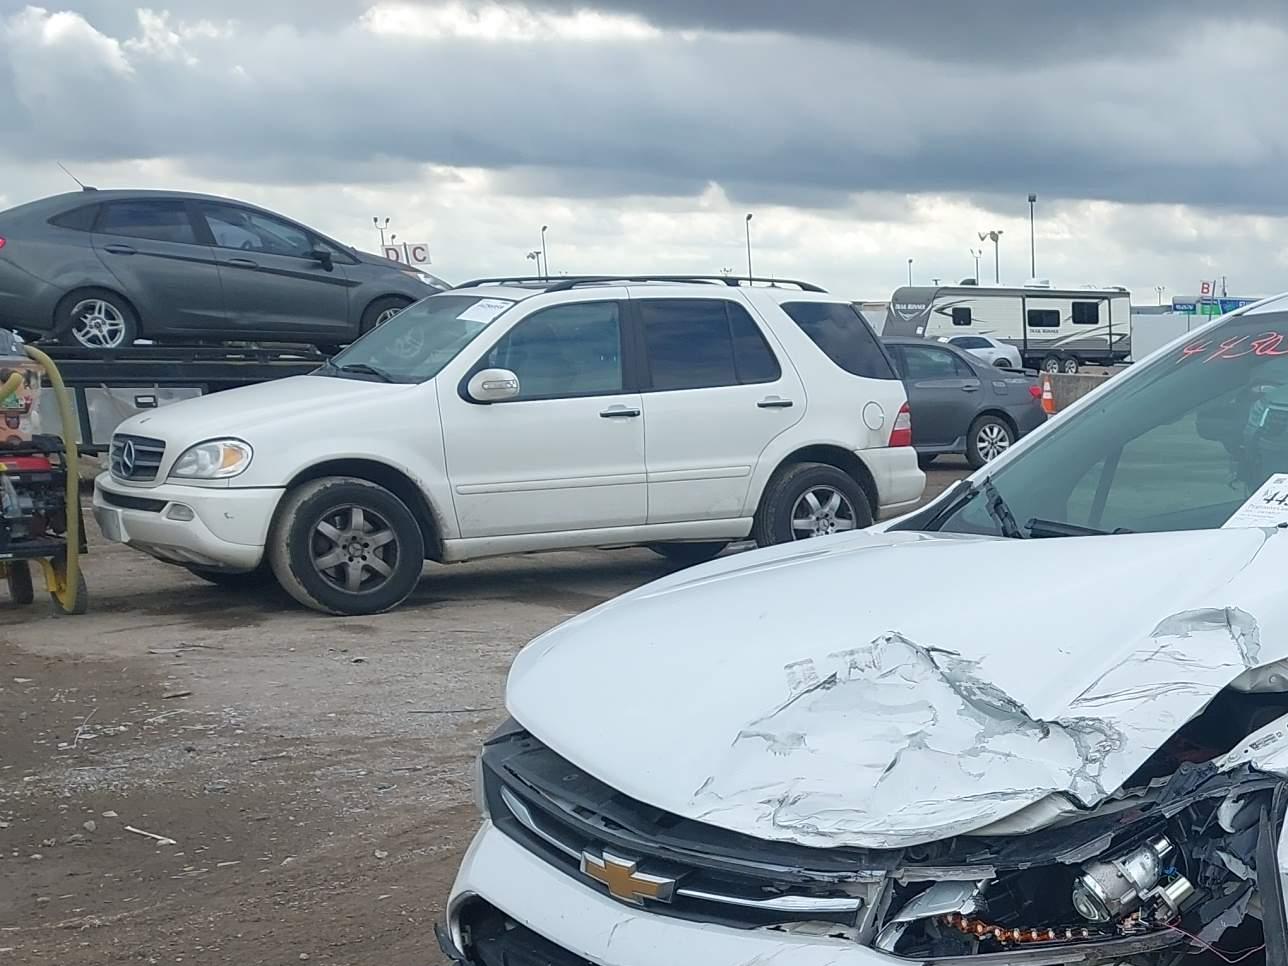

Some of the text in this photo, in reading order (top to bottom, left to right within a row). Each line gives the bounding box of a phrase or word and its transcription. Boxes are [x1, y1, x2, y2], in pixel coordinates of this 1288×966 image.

[385, 247, 400, 262] D
[412, 246, 427, 262] C
[1200, 282, 1210, 294] B
